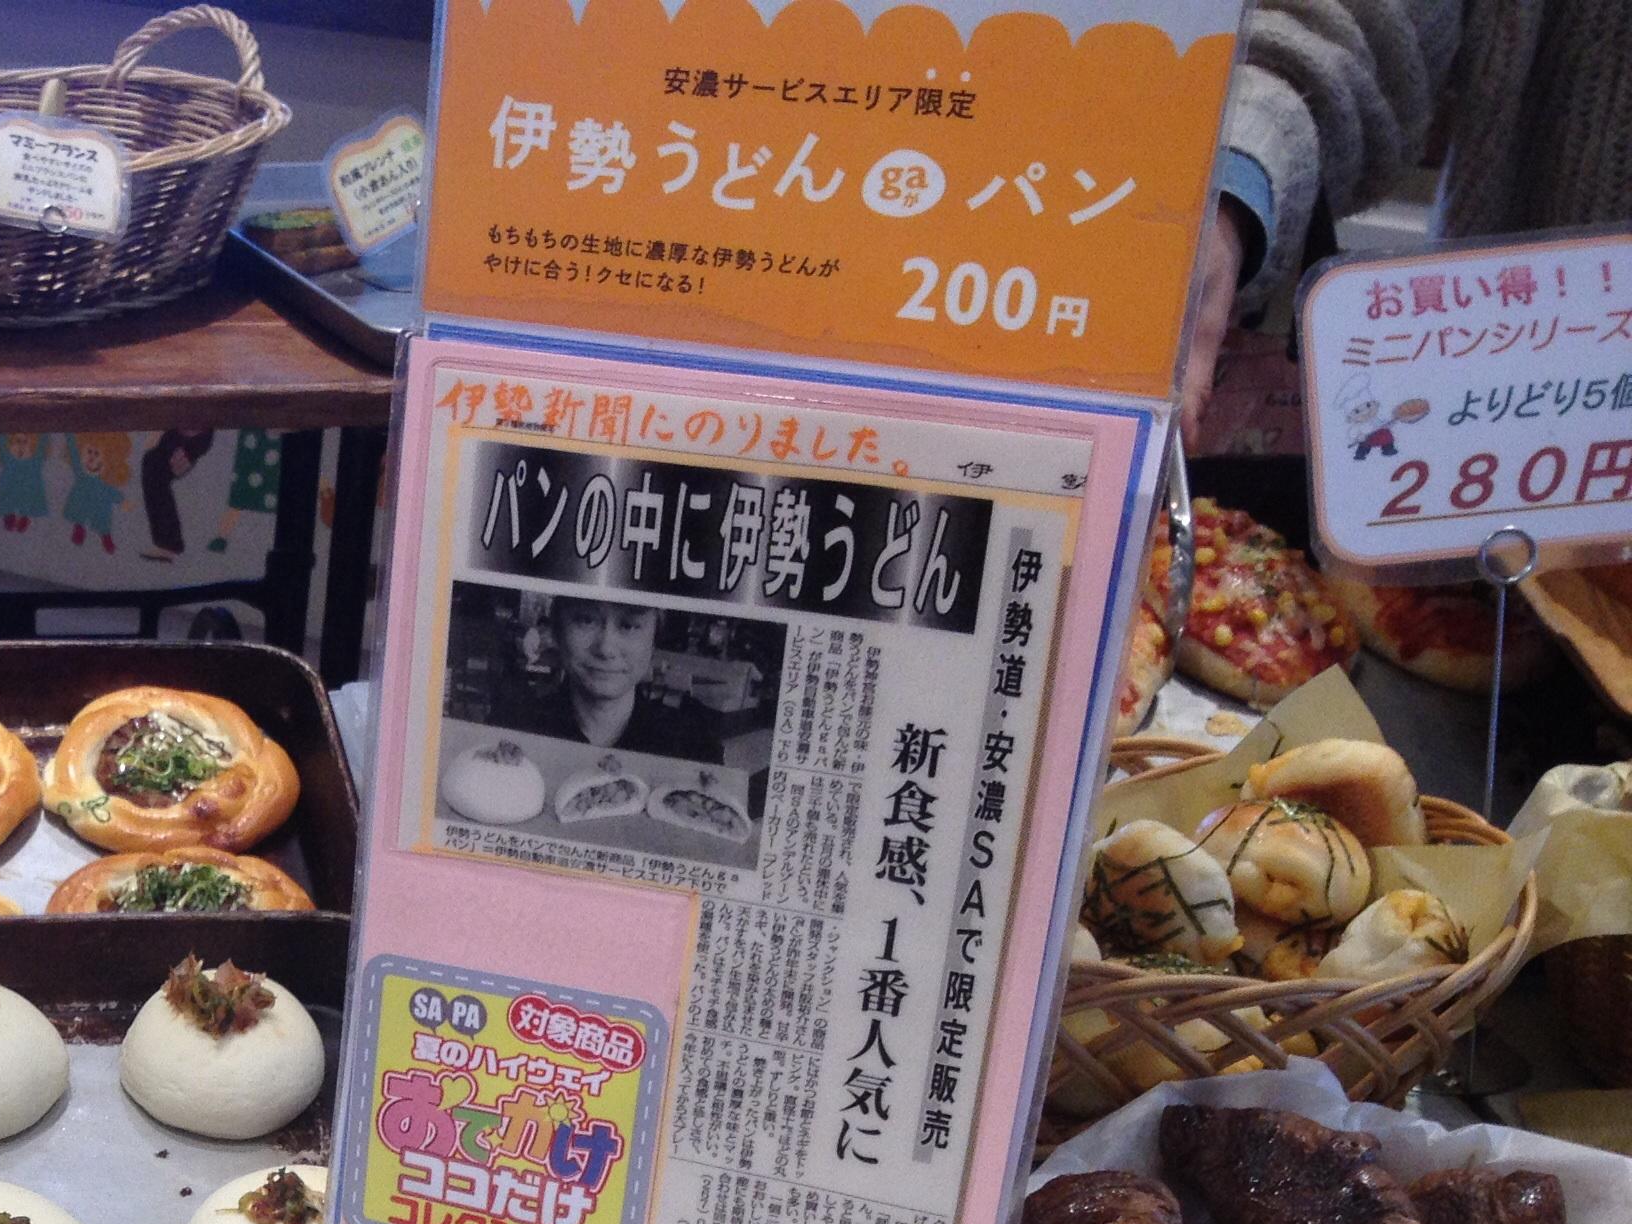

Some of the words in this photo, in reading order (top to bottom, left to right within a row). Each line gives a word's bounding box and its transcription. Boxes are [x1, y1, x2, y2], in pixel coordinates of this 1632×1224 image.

[664, 66, 977, 120] 安濃サービスエリア限定
[489, 94, 846, 210] 伊勢うどん
[966, 160, 1137, 227] パン
[487, 223, 841, 278] もちもちの生地に濃厚な伊勢うどんが
[436, 377, 910, 479] 伊勢新聞にのりました。
[480, 459, 963, 616] パンの中に伊勢うどん
[413, 993, 443, 1022] SA
[451, 1001, 480, 1030] PA
[517, 1002, 636, 1068] 対象商品
